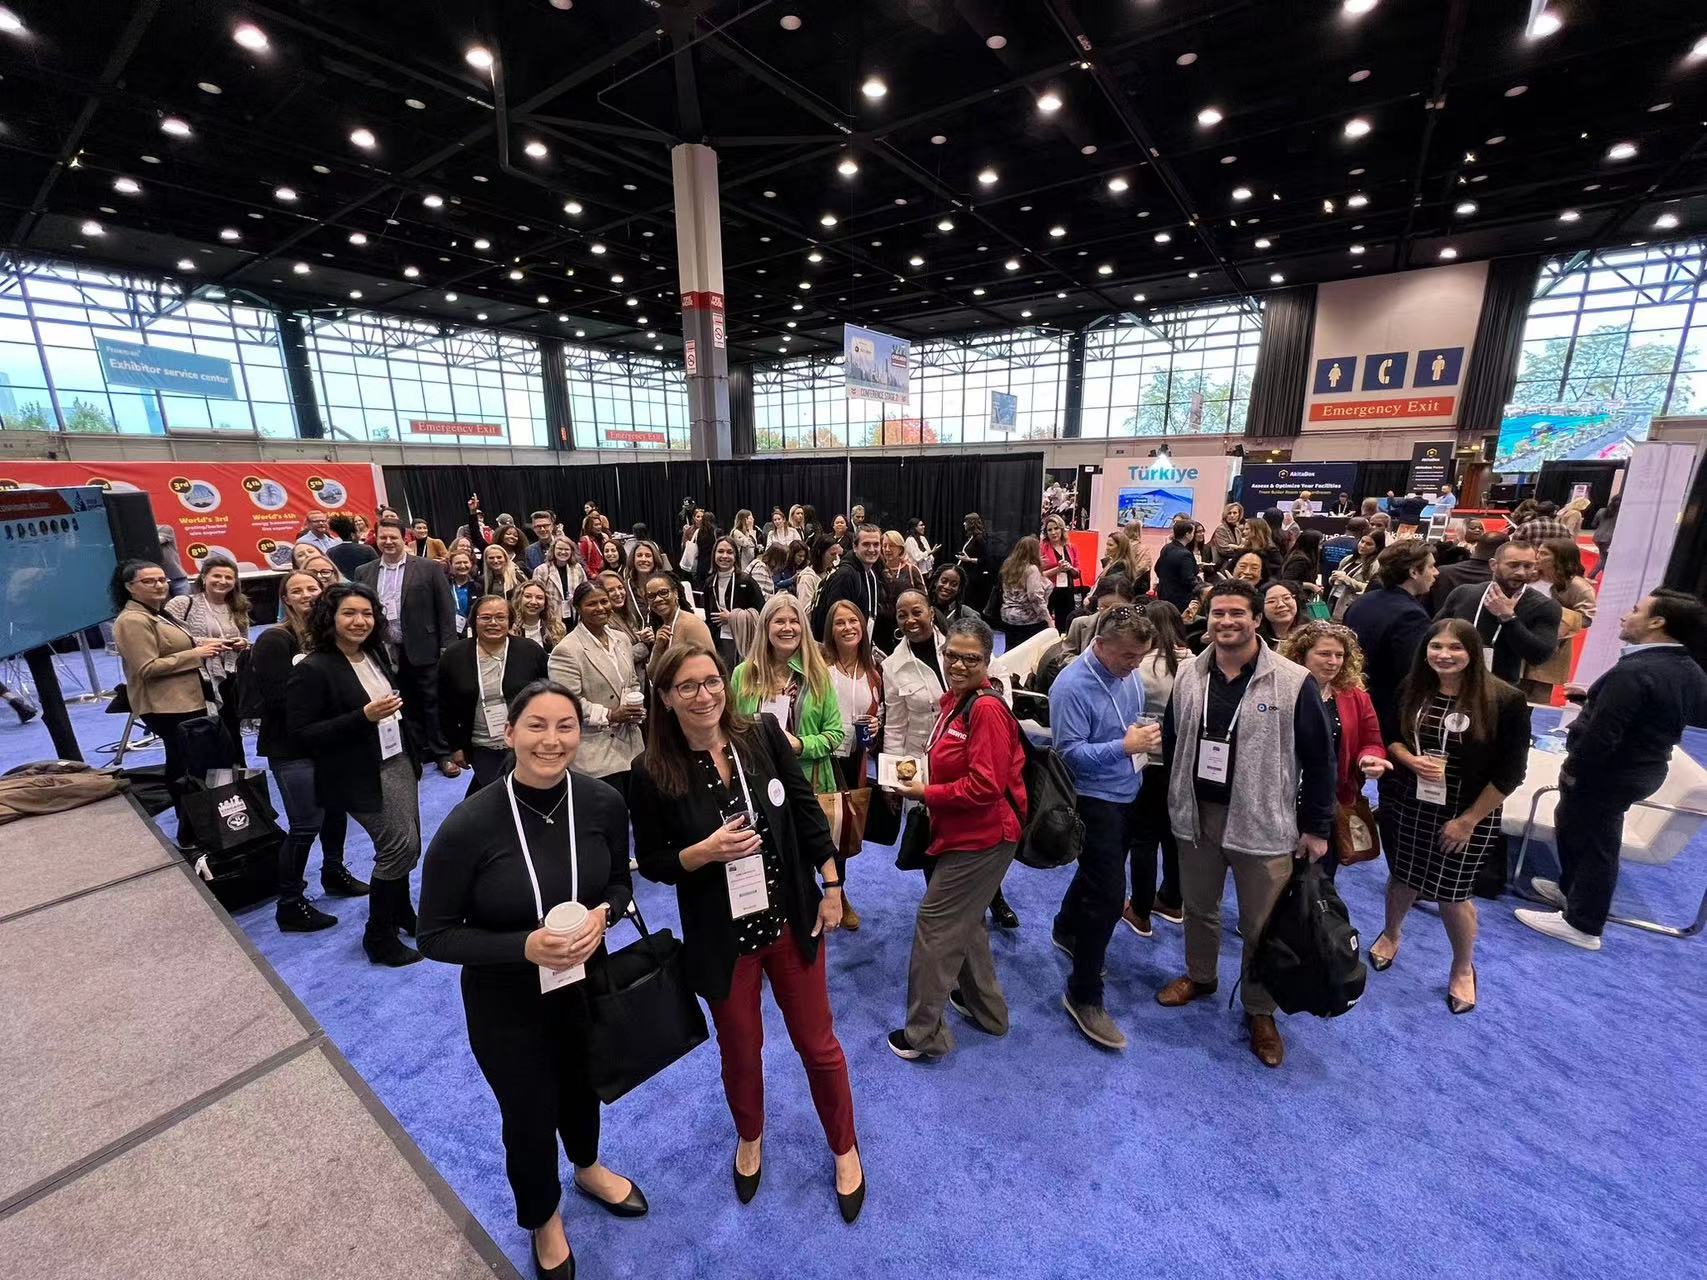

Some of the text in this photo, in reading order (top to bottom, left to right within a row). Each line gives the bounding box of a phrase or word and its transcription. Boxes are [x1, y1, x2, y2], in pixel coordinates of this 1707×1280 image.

[110, 358, 229, 384] Exhibitor service center
[860, 388, 884, 400] CONFERENCE
[1323, 400, 1439, 417] Emergency Exit
[418, 421, 496, 434] Emergency Exit
[610, 431, 646, 441] Emergency
[1128, 465, 1199, 483] Türkiye
[173, 482, 189, 491] 3rd
[246, 481, 260, 490] 4th
[310, 480, 323, 489] 5th
[251, 513, 282, 521] World's
[260, 542, 275, 550] 8th
[191, 548, 207, 556] 8th
